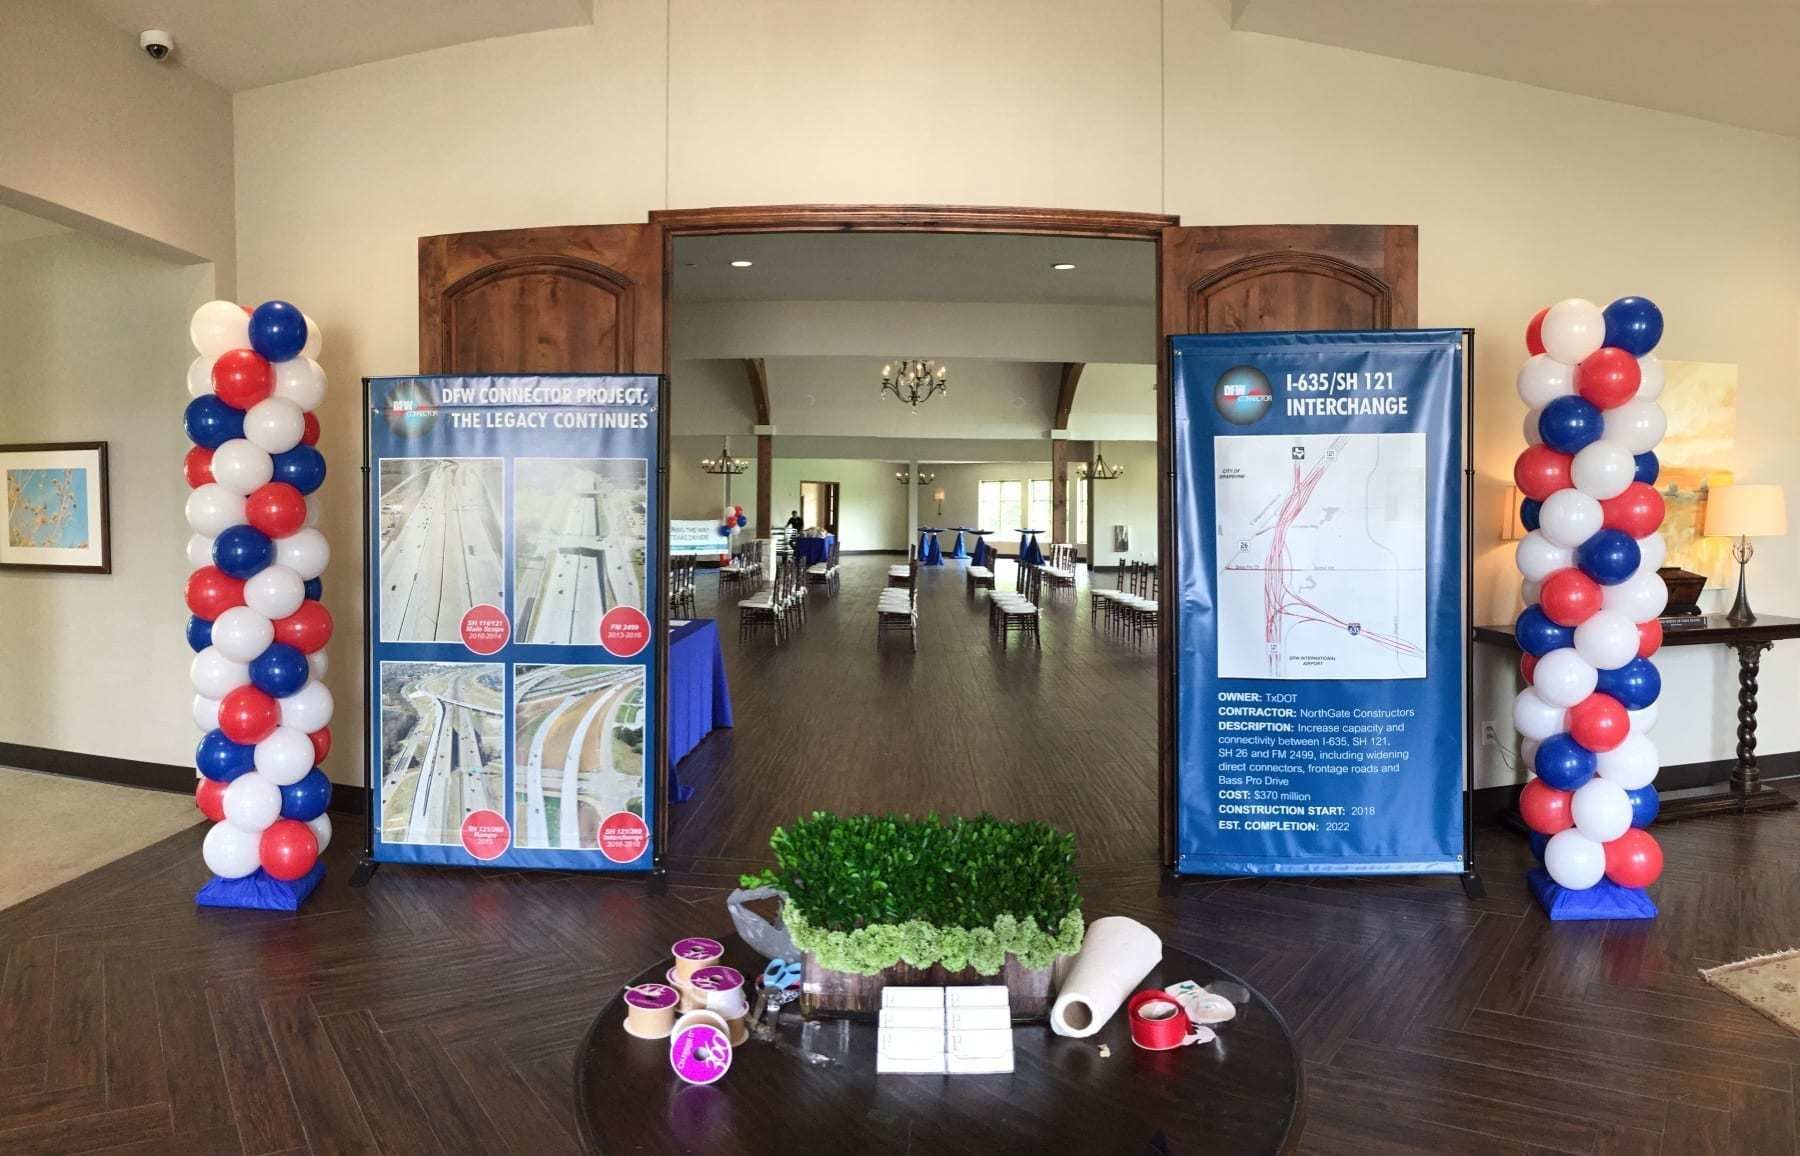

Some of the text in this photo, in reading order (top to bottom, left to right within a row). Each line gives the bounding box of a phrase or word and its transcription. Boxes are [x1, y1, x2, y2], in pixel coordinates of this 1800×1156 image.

[1286, 372, 1393, 395] I-635/SH 121
[443, 389, 474, 404] DFW
[479, 388, 574, 404] CONNECTOR
[1223, 385, 1246, 396] DFW
[393, 400, 413, 411] DFW
[1286, 397, 1408, 417] INTERCHANGE
[451, 413, 649, 429] THE LEGACY CONTINUES
[1218, 692, 1298, 703] OWNER: TxDOT
[1218, 707, 1415, 718] CONTRACTOR: NorthGate Constructors
[1218, 722, 1405, 734] DESCRIPTION: Increase capacity and
[1218, 736, 1276, 746] connectivity
[1278, 737, 1319, 746] between
[1352, 737, 1367, 746] SH
[1218, 749, 1409, 761] SH 26 and FM 2499, including widening
[1218, 763, 1400, 775] direct connectors, frontage roads and
[1218, 776, 1289, 786] Bass Pro Drive
[1218, 790, 1311, 801] COST: $370 million
[1218, 805, 1376, 816] CONSTRUCTION START: 2018
[1218, 820, 1350, 832] EST. COMPLETION: 2022
